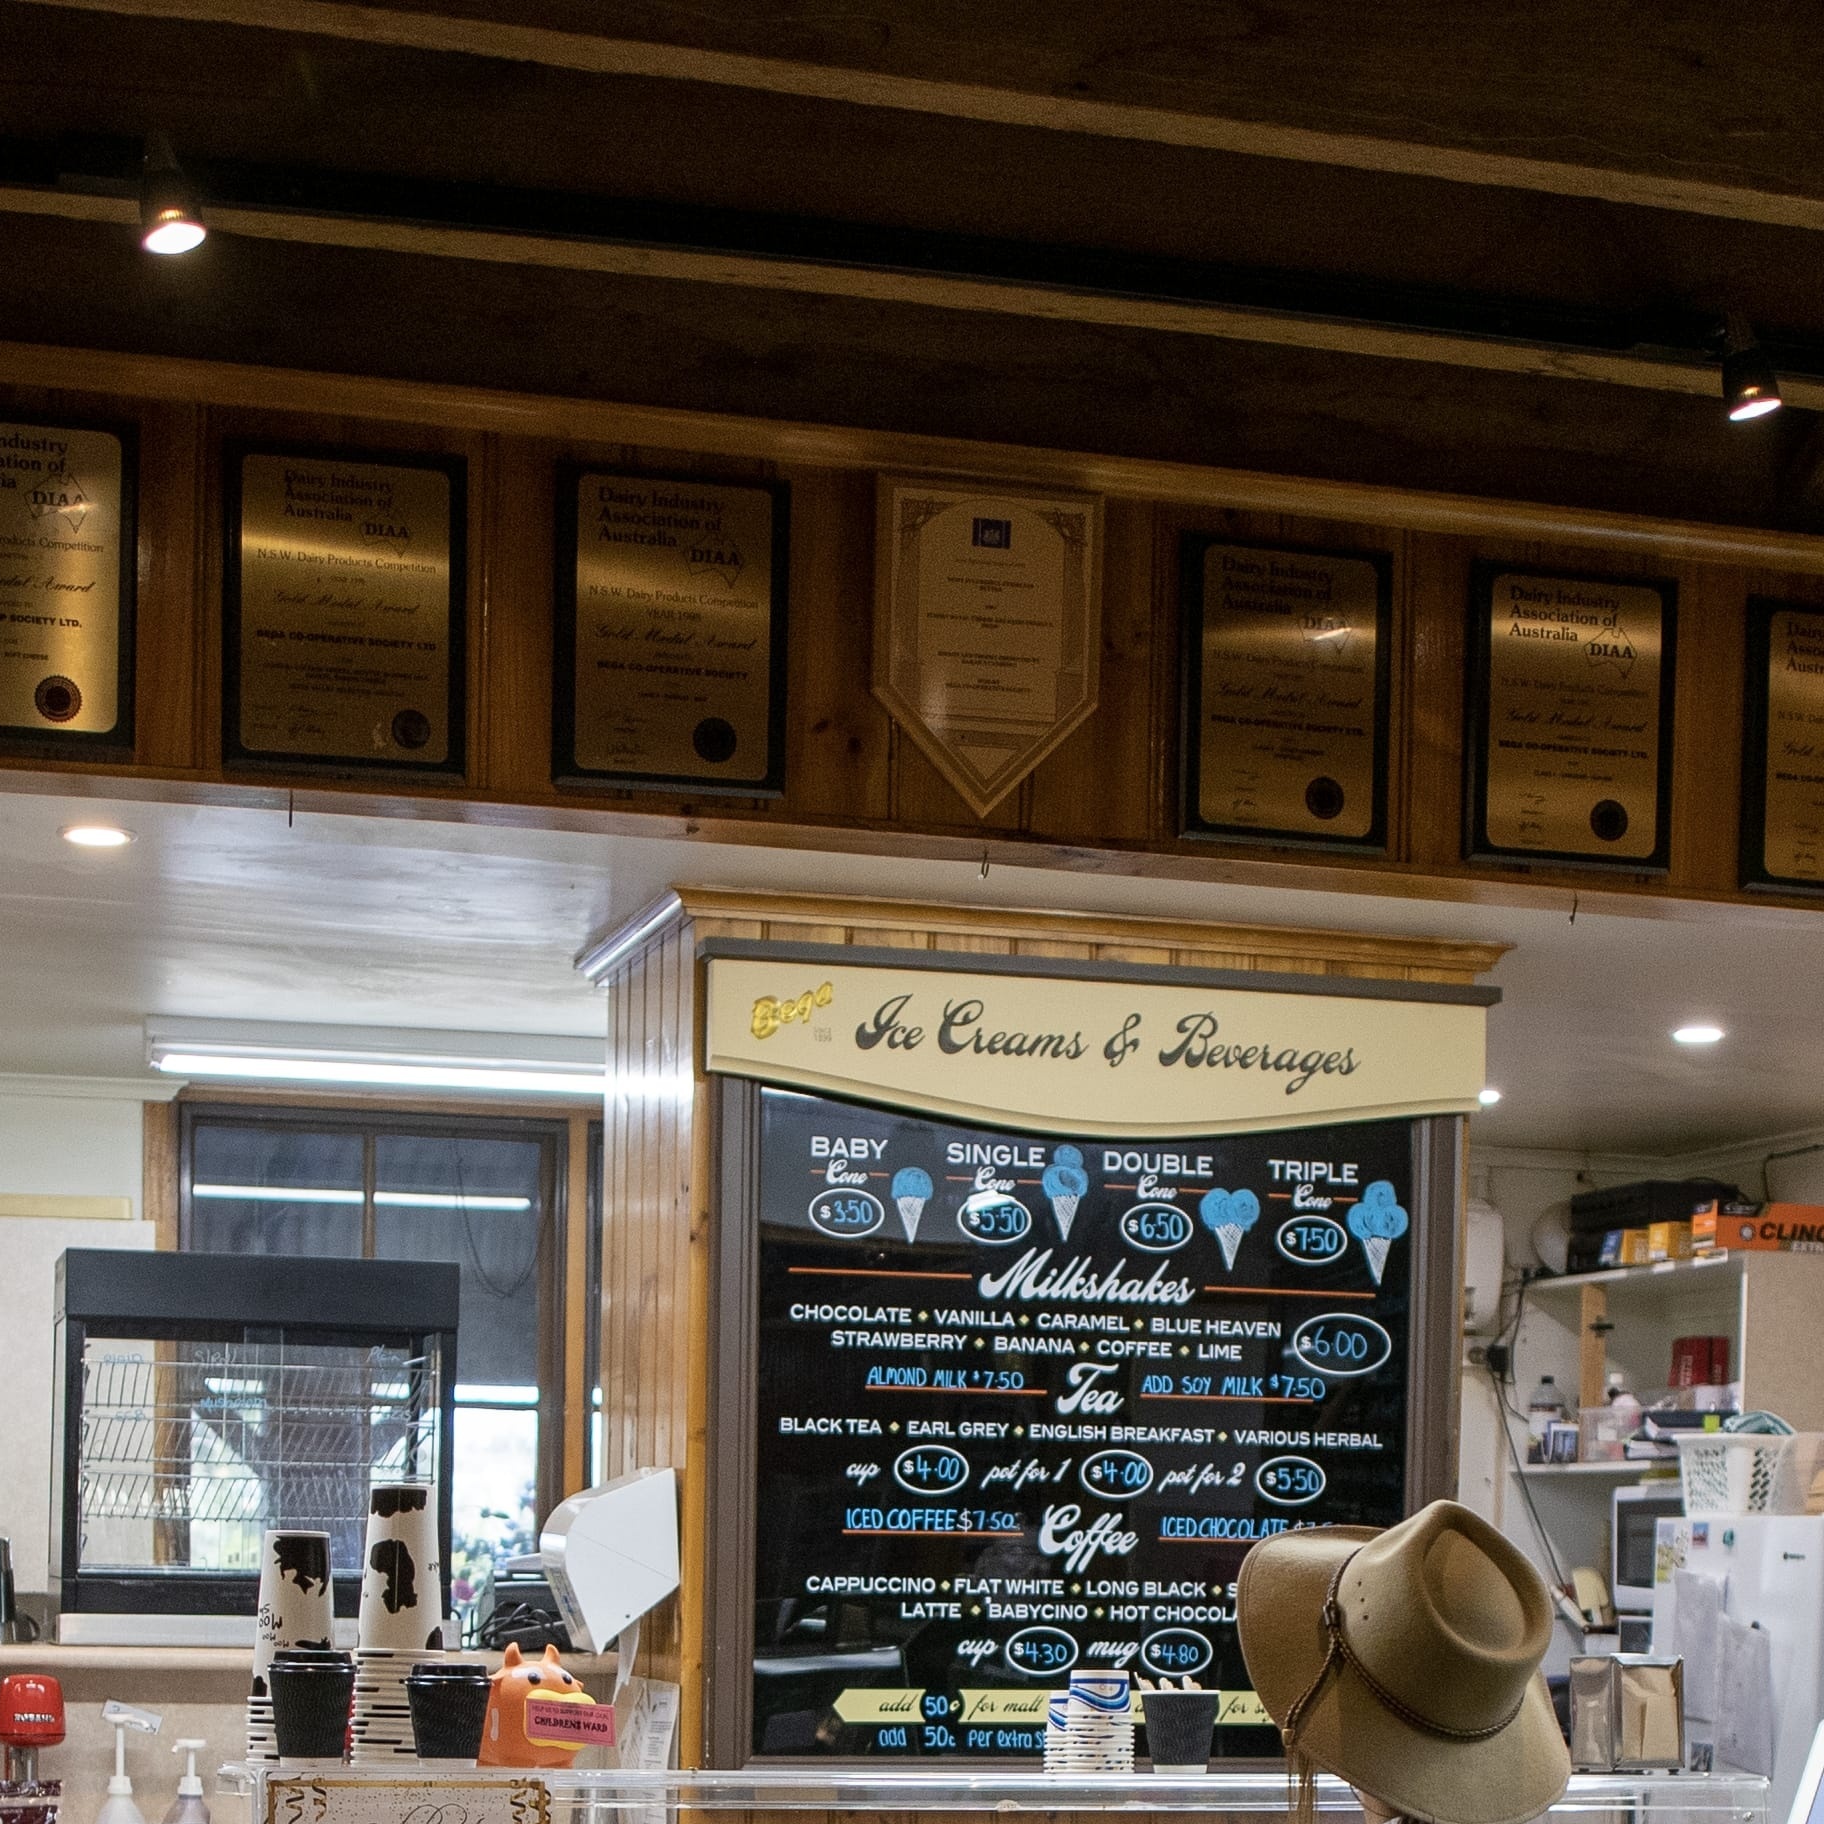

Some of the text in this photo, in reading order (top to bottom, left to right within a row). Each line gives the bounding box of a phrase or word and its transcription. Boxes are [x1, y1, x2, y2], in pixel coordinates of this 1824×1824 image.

[48, 457, 67, 473] of
[1509, 604, 1619, 628] Association of
[1509, 622, 1579, 643] Australia
[1589, 642, 1634, 660] DIAA
[750, 980, 834, 1040] Bega
[855, 993, 1361, 1096] Ice Creams & Beverages
[810, 1136, 1359, 1184] BABY SINGLE DOUBLE TRIPLE
[827, 1159, 1333, 1210] Cone Cone Cone Cone
[978, 1245, 1196, 1305] Milkshakes
[790, 1303, 1282, 1338] CHOCOLATE VANILLA CARAMEL BLUE HEAVEN
[831, 1330, 1243, 1361] STRAWBERRY BANANA COFFEE LIME
[867, 1366, 968, 1390] ALMOND MILK
[1055, 1361, 1125, 1415] Tea
[1140, 1374, 1264, 1397] ADD SOY MILK
[780, 1417, 1383, 1449] BLACK TEA EARL GREY ENGLISH BREAKFAST VARIOUS HERBAL
[846, 1461, 881, 1487] cup
[846, 1507, 958, 1532] ICED COFFEE
[1161, 1516, 1289, 1540] ICED CHOCOLATE
[1038, 1503, 1139, 1573] Coffee
[805, 1575, 1207, 1598] CAPPUCCINO FLAT WHITE LONG BLACK
[900, 1602, 1237, 1622] LATTE BABYCINO HOT CHOCOLA
[957, 1638, 1000, 1667] cup
[1087, 1639, 1142, 1667] mug
[582, 1721, 608, 1733] WARD
